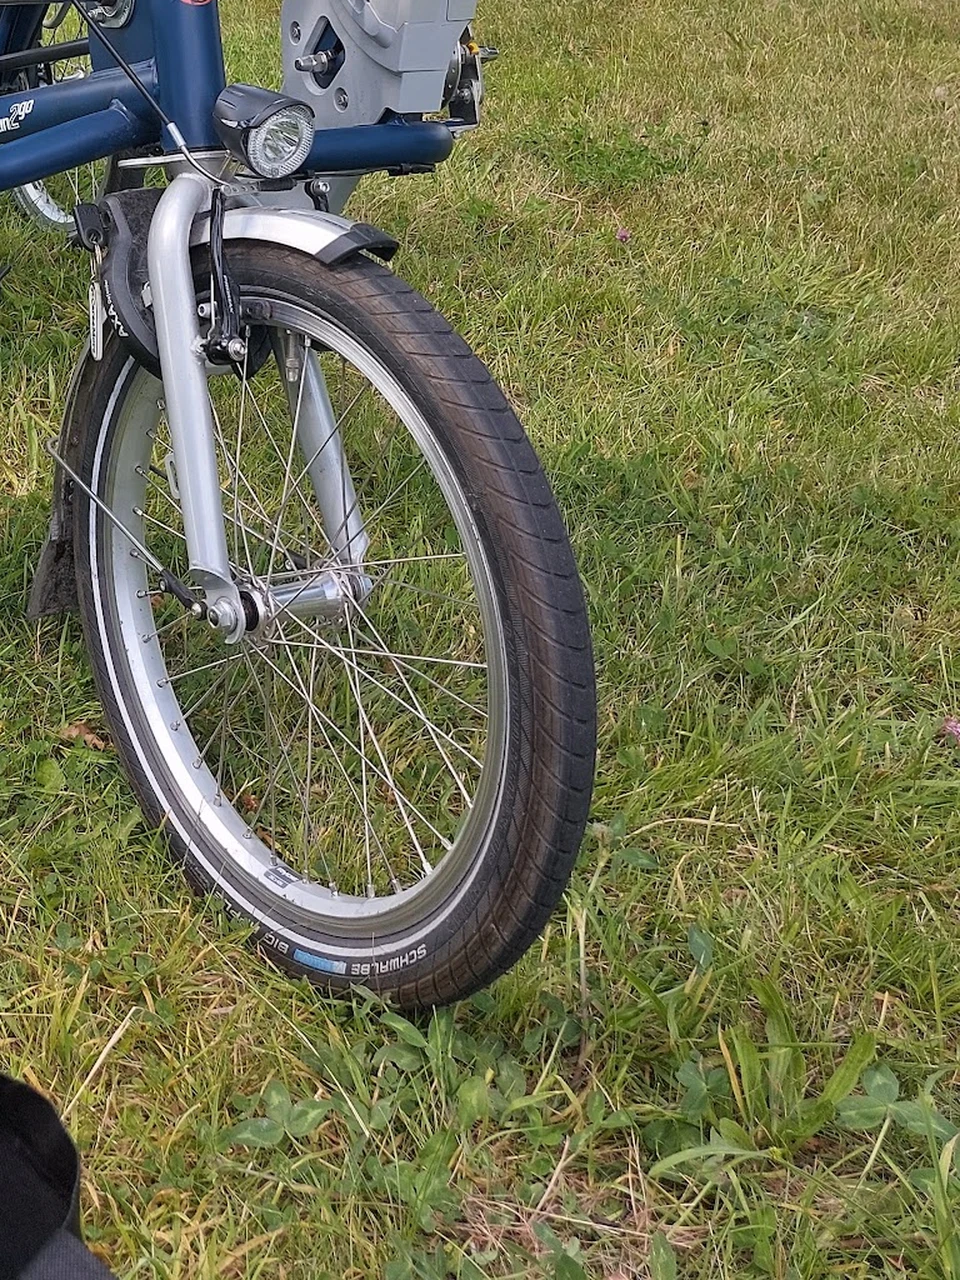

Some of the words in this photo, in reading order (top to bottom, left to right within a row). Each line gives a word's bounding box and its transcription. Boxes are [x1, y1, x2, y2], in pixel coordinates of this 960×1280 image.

[108, 304, 129, 337] AXA
[261, 931, 290, 955] BIG
[350, 943, 428, 976] SCHWALBE
